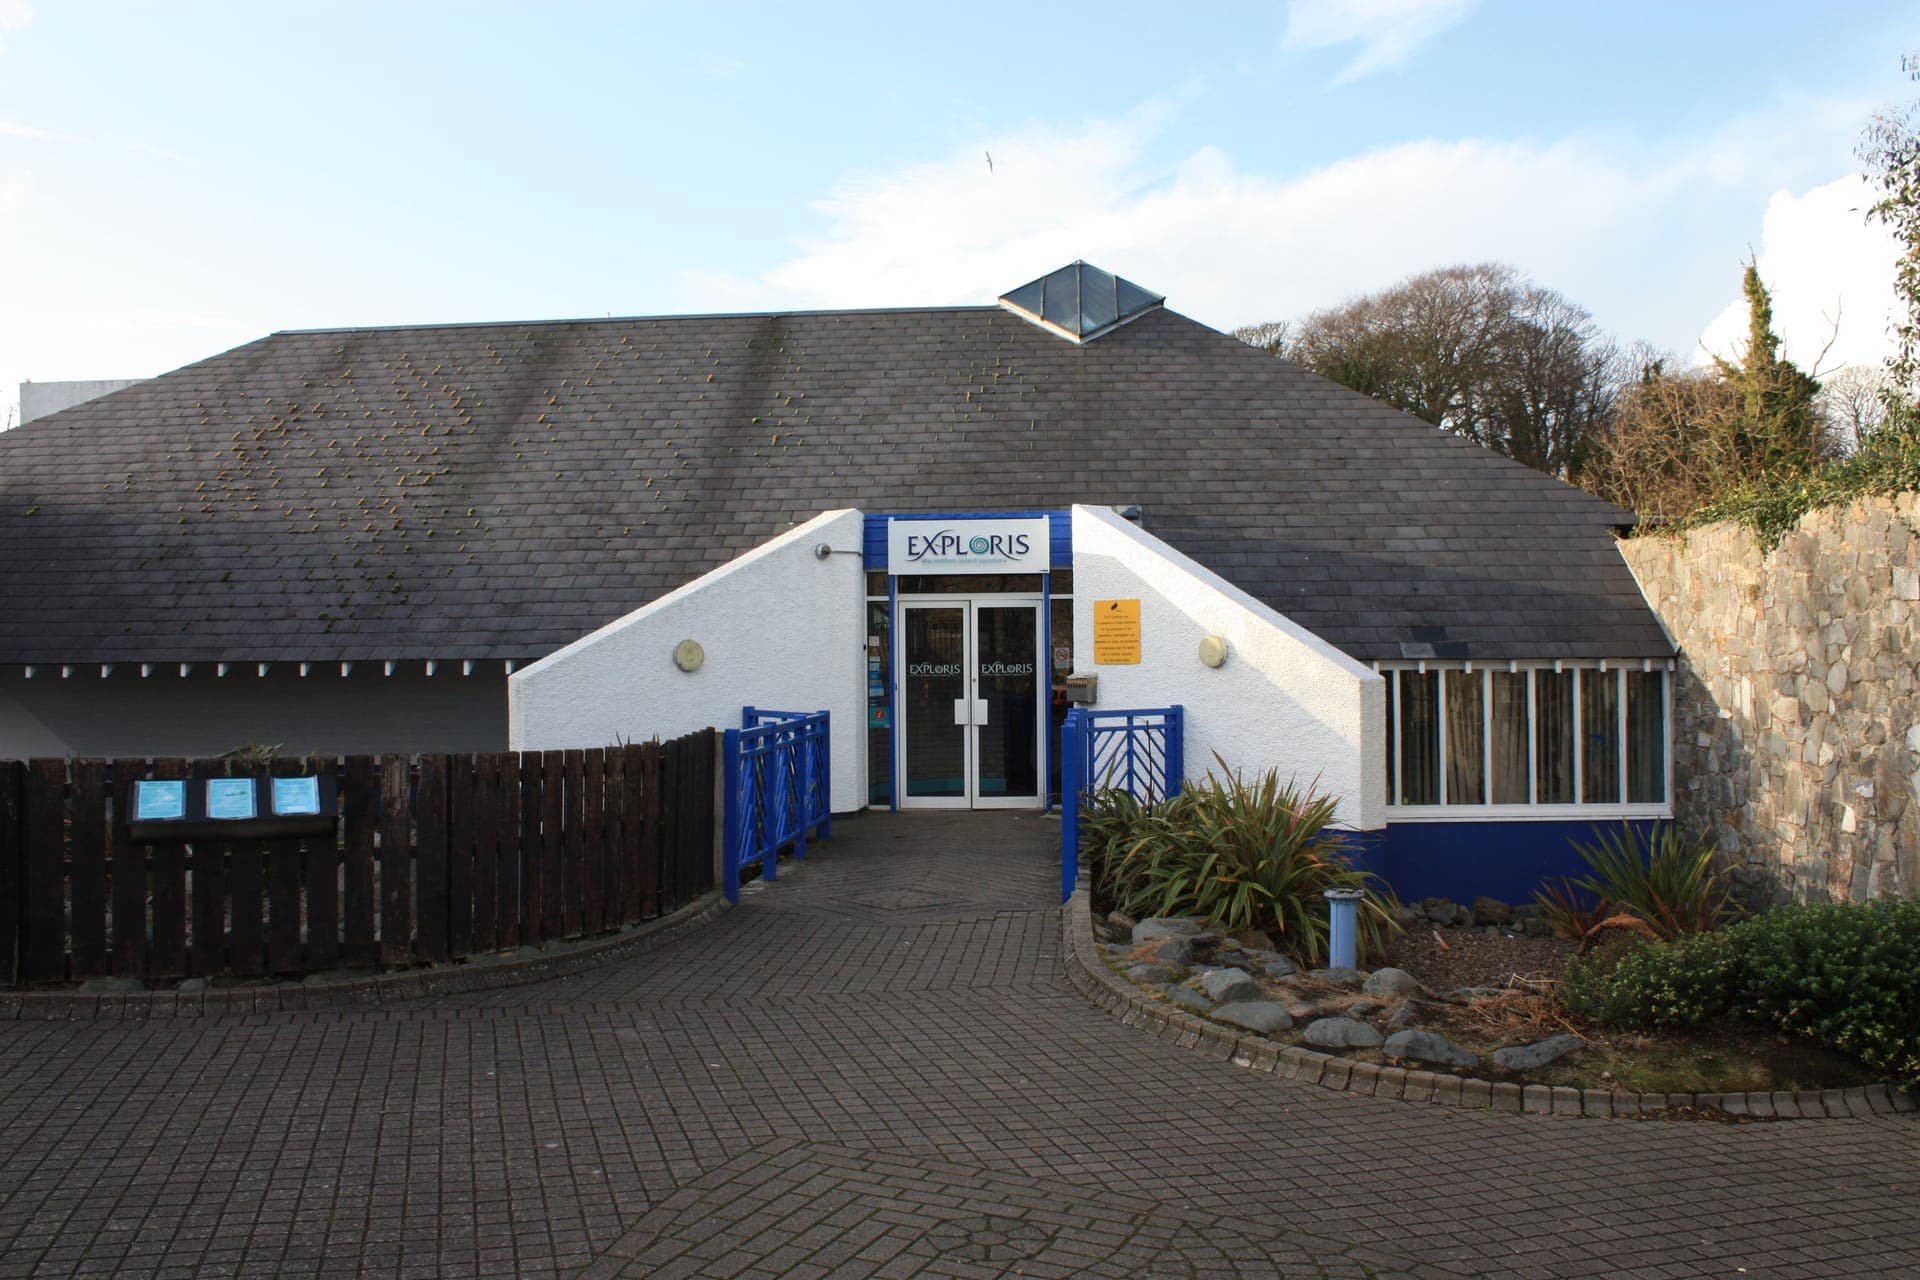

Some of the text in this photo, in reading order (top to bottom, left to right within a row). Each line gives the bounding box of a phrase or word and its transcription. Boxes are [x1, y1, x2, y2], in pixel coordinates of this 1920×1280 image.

[905, 530, 1030, 561] EXPLORIS
[908, 662, 961, 676] EXPLORIS
[981, 661, 1033, 676] EXPLORIS
